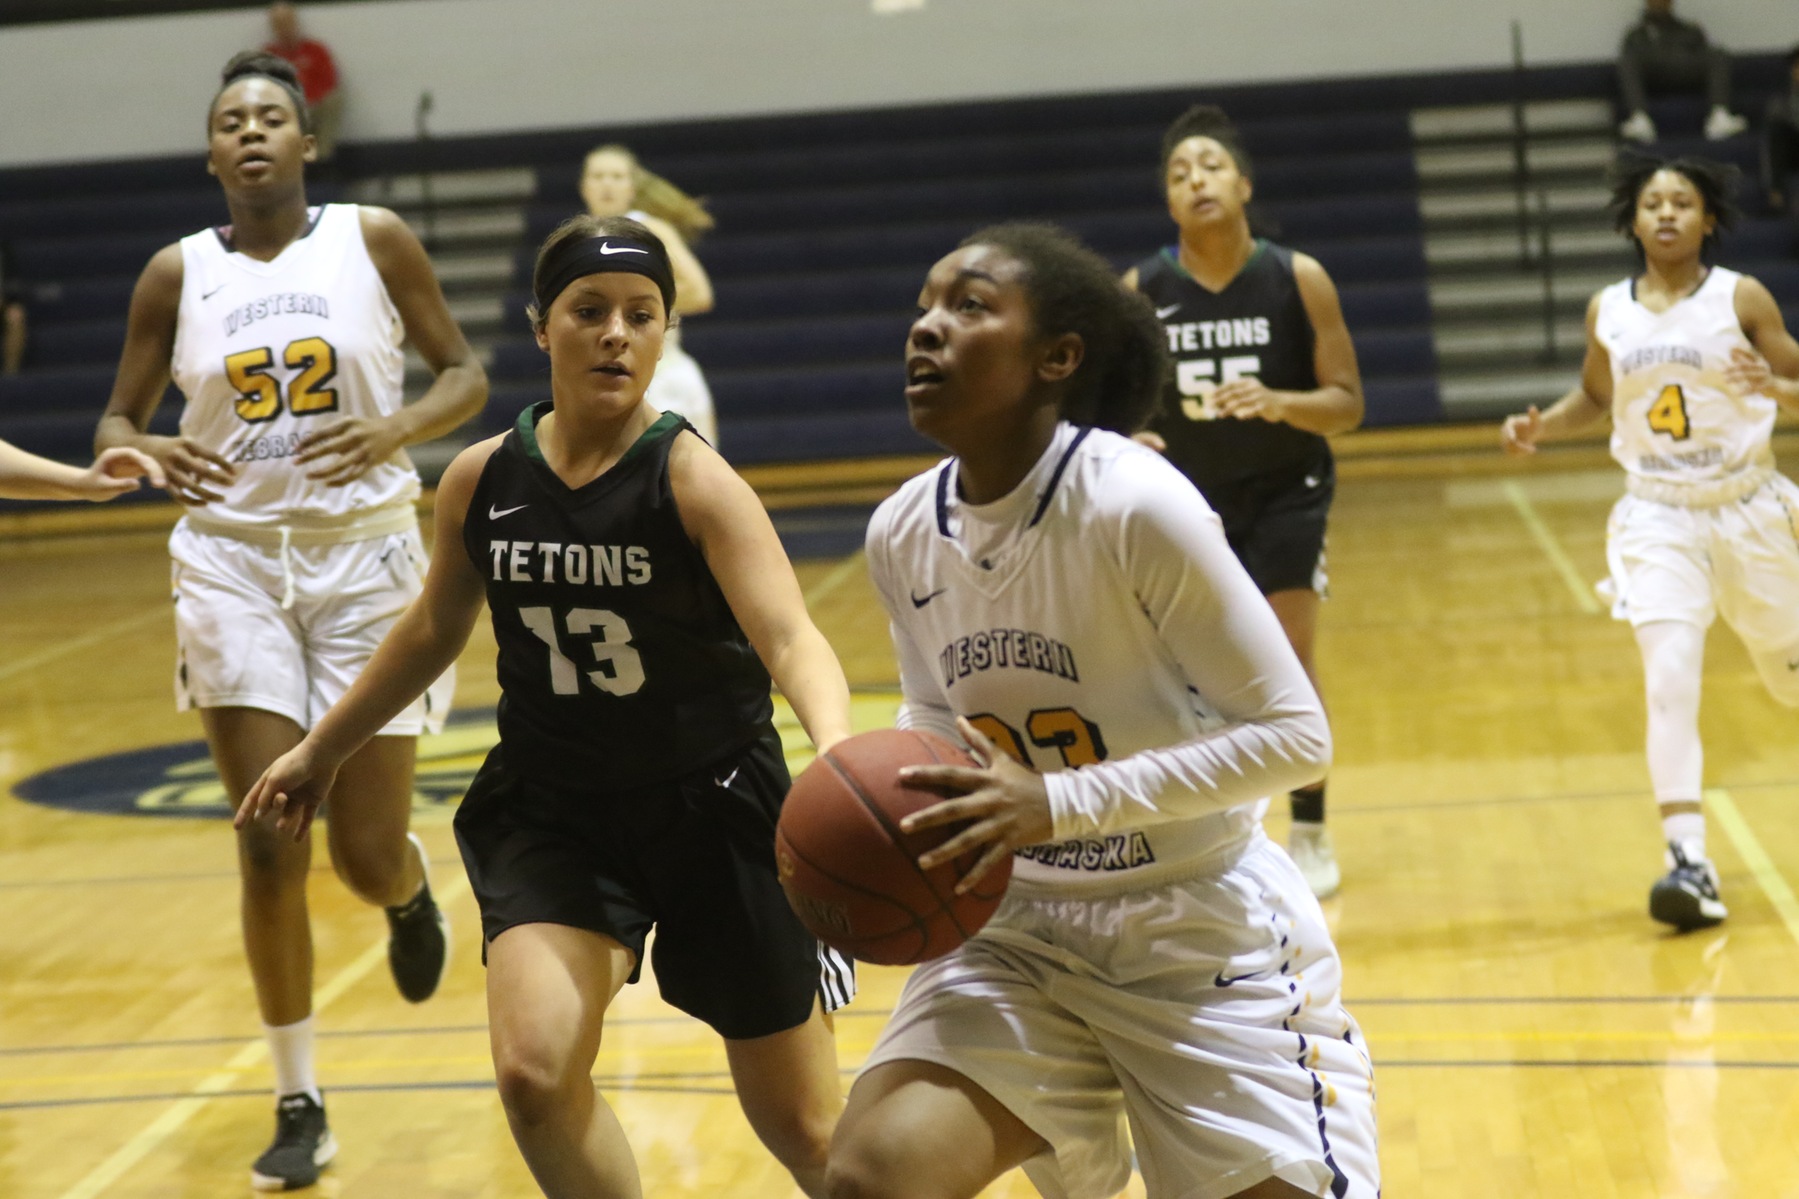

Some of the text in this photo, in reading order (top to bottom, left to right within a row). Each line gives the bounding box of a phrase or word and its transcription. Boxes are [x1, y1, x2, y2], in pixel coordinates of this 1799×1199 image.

[222, 292, 329, 337] WESTERN
[1166, 317, 1270, 352] TETONS
[224, 336, 338, 425] 52
[1646, 384, 1690, 441] 4
[489, 540, 652, 586] TETONS
[518, 606, 646, 697] 13
[939, 629, 1079, 688] WESTERN
